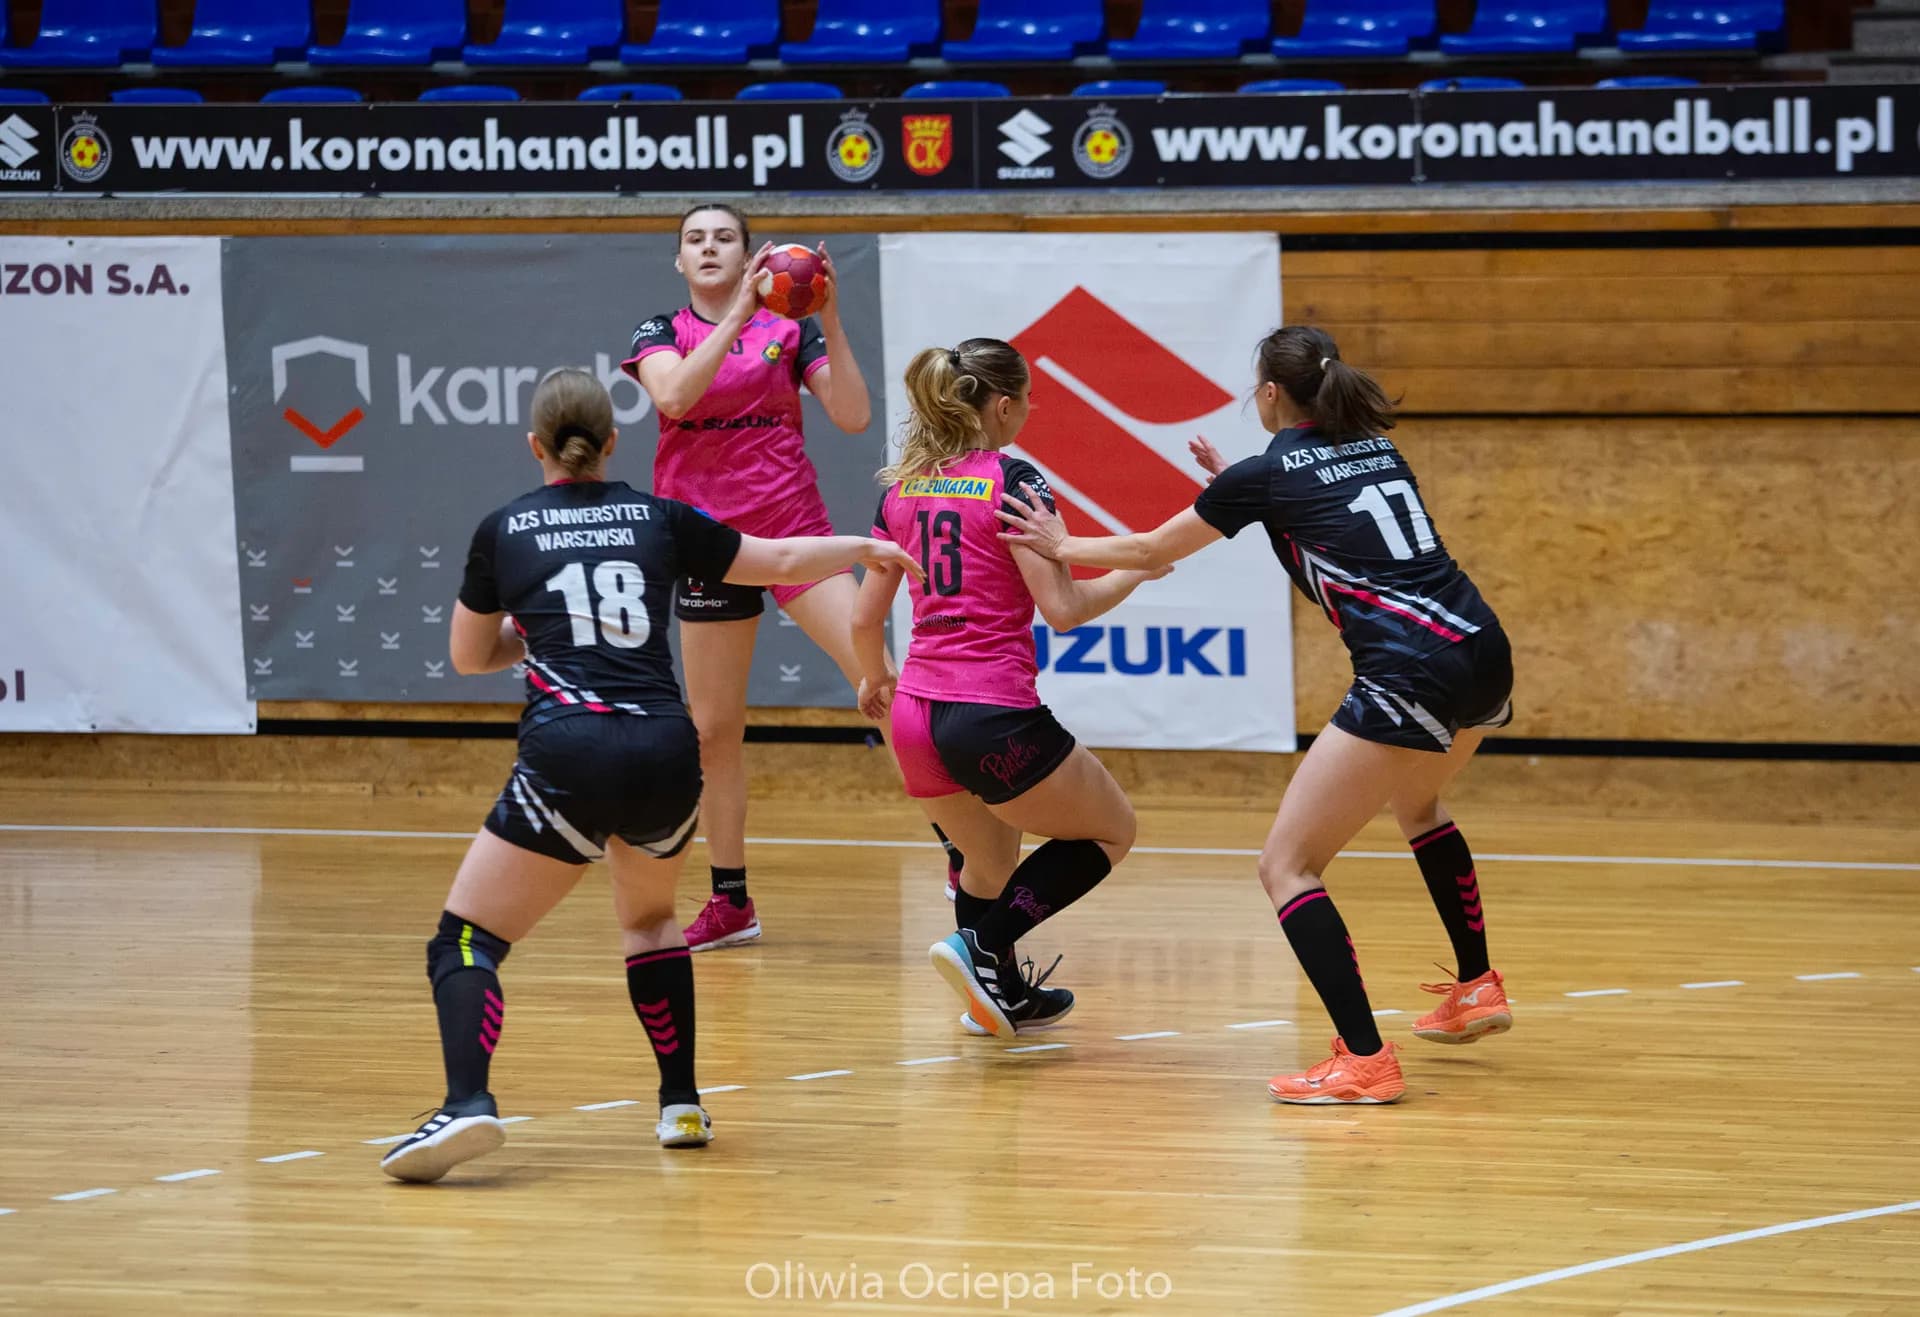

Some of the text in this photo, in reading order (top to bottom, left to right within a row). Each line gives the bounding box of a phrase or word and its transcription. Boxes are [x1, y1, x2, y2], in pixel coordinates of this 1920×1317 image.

[132, 115, 803, 185] www.koronahandball.pl
[1152, 97, 1894, 171] www.koronahandball.pl
[0, 170, 40, 180] UZUKI
[998, 167, 1054, 179] SUZUKI
[0, 263, 190, 295] ZON S.A.
[1282, 449, 1314, 471] AZS
[507, 504, 650, 534] AZS UNIWERSYTET
[1347, 479, 1436, 560] 17
[535, 528, 635, 551] WARSZWSKI
[917, 510, 962, 596] 13
[546, 560, 650, 648] 18
